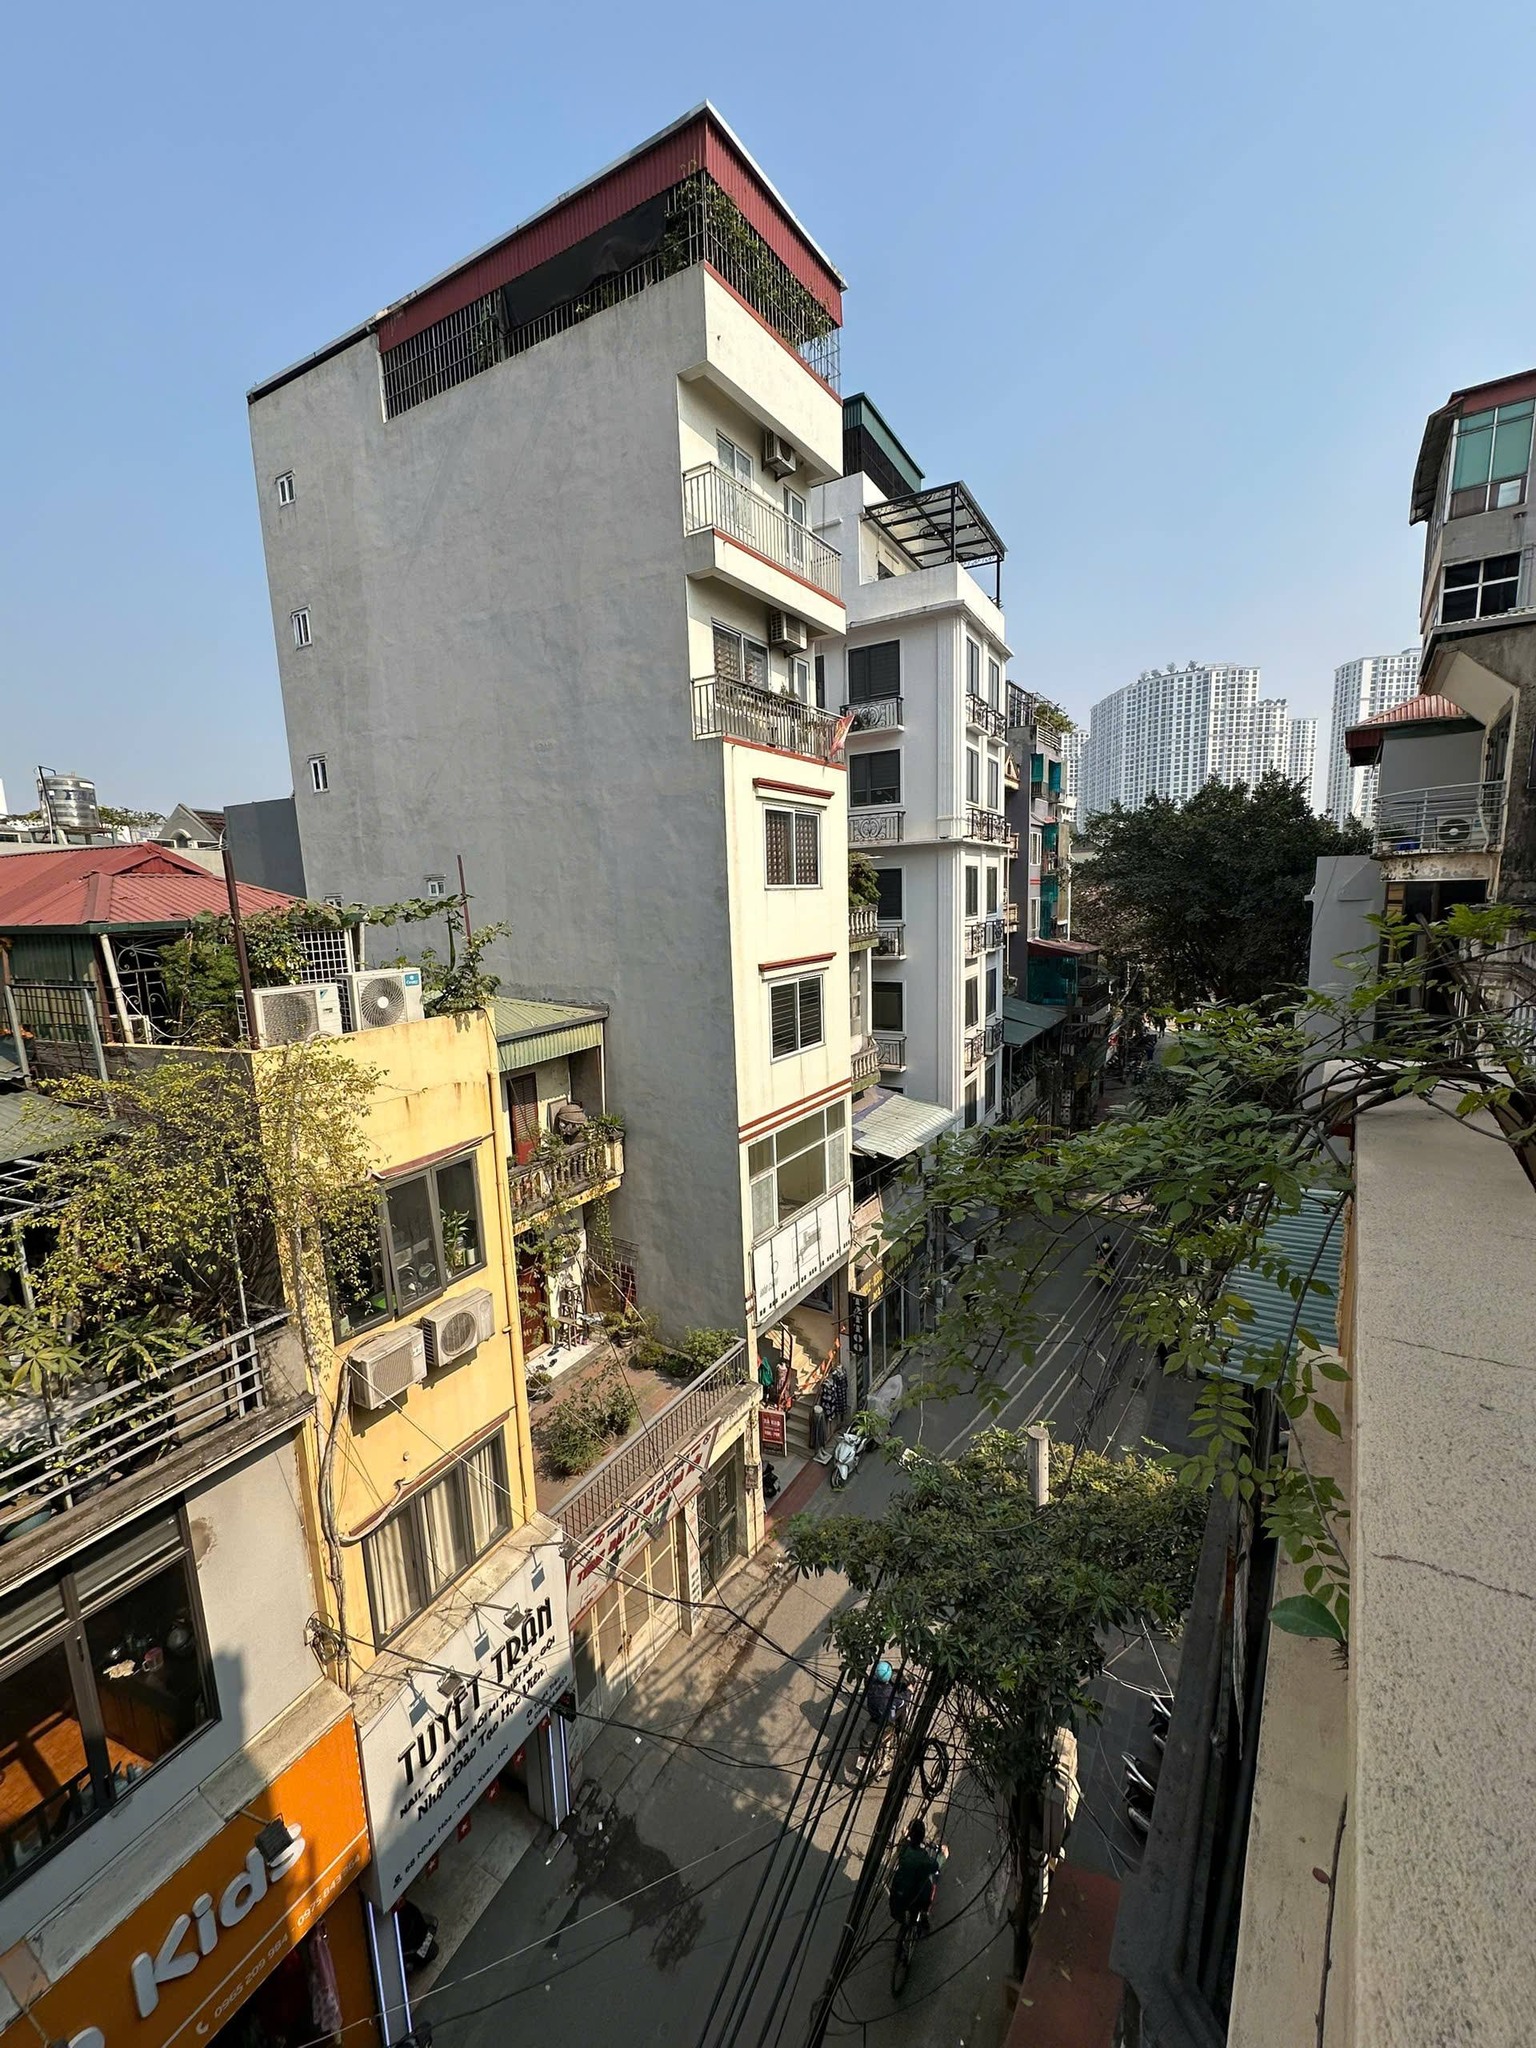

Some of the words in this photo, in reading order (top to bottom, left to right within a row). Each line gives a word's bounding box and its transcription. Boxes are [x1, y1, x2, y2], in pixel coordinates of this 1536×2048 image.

[400, 1788, 424, 1820] NAIL
[488, 1699, 499, 1718] MI
[540, 1636, 555, 1656] GỘI
[417, 1777, 452, 1821] Nhận
[478, 1721, 499, 1747] Tạo
[500, 1695, 521, 1722] Học
[457, 1785, 476, 1809] Thanh
[131, 1822, 307, 2019] Kids
[214, 1983, 244, 2019] 0965
[244, 1958, 266, 1985] 209
[297, 1895, 322, 1928] 0975
